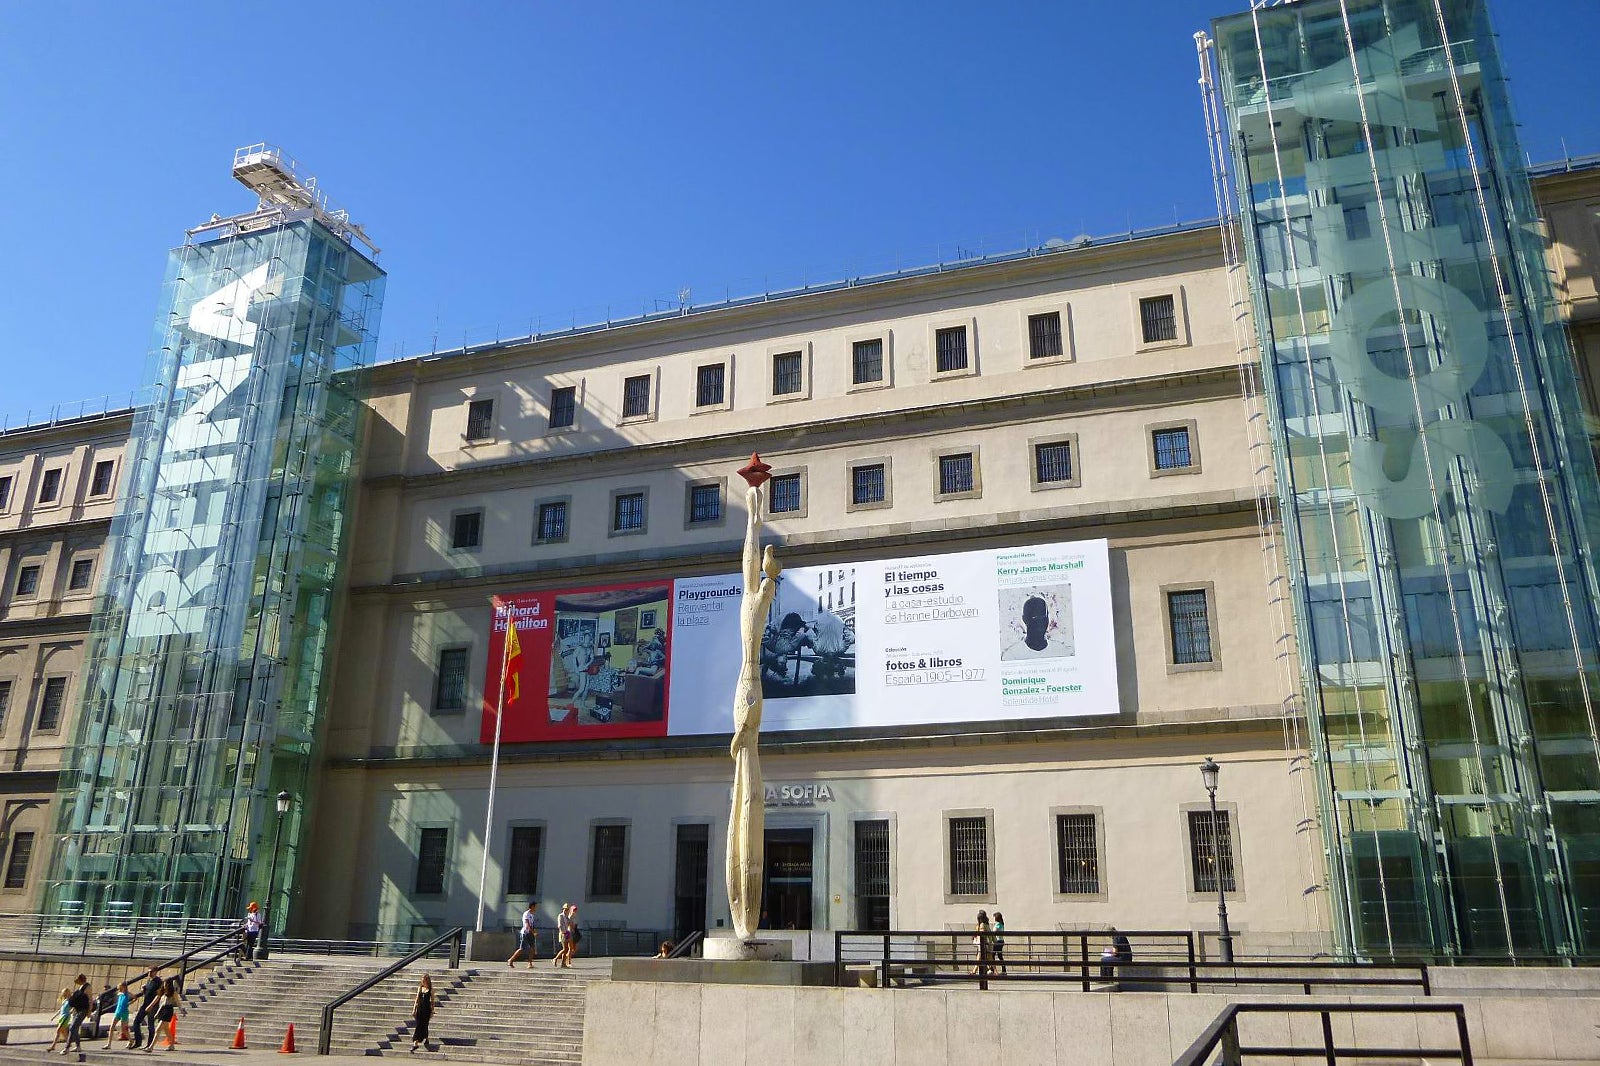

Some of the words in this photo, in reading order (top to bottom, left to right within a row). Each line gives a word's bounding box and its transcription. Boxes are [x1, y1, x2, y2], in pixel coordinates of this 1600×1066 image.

[127, 261, 269, 637] REINA
[997, 567, 1018, 576] Kerry
[1020, 565, 1047, 573] James
[1048, 561, 1084, 570] Marshall
[885, 572, 896, 582] El
[898, 570, 937, 582] tiempo
[678, 586, 742, 600] Playgrounds
[884, 588, 891, 598] y
[893, 585, 910, 595] las
[912, 583, 944, 593] cosas
[885, 599, 897, 610] La
[899, 594, 964, 608] casa-estudio
[678, 616, 685, 625] la
[686, 615, 709, 626] plaza
[885, 613, 897, 623] de
[899, 611, 931, 622] Hanne
[932, 608, 979, 619] Darboven
[885, 660, 916, 671] fotos
[918, 658, 927, 669] &
[929, 657, 962, 667] libros
[885, 673, 922, 685] España
[1002, 677, 1046, 687] Dominique
[1046, 684, 1082, 693] Foerster
[781, 784, 830, 800] SOFIA
